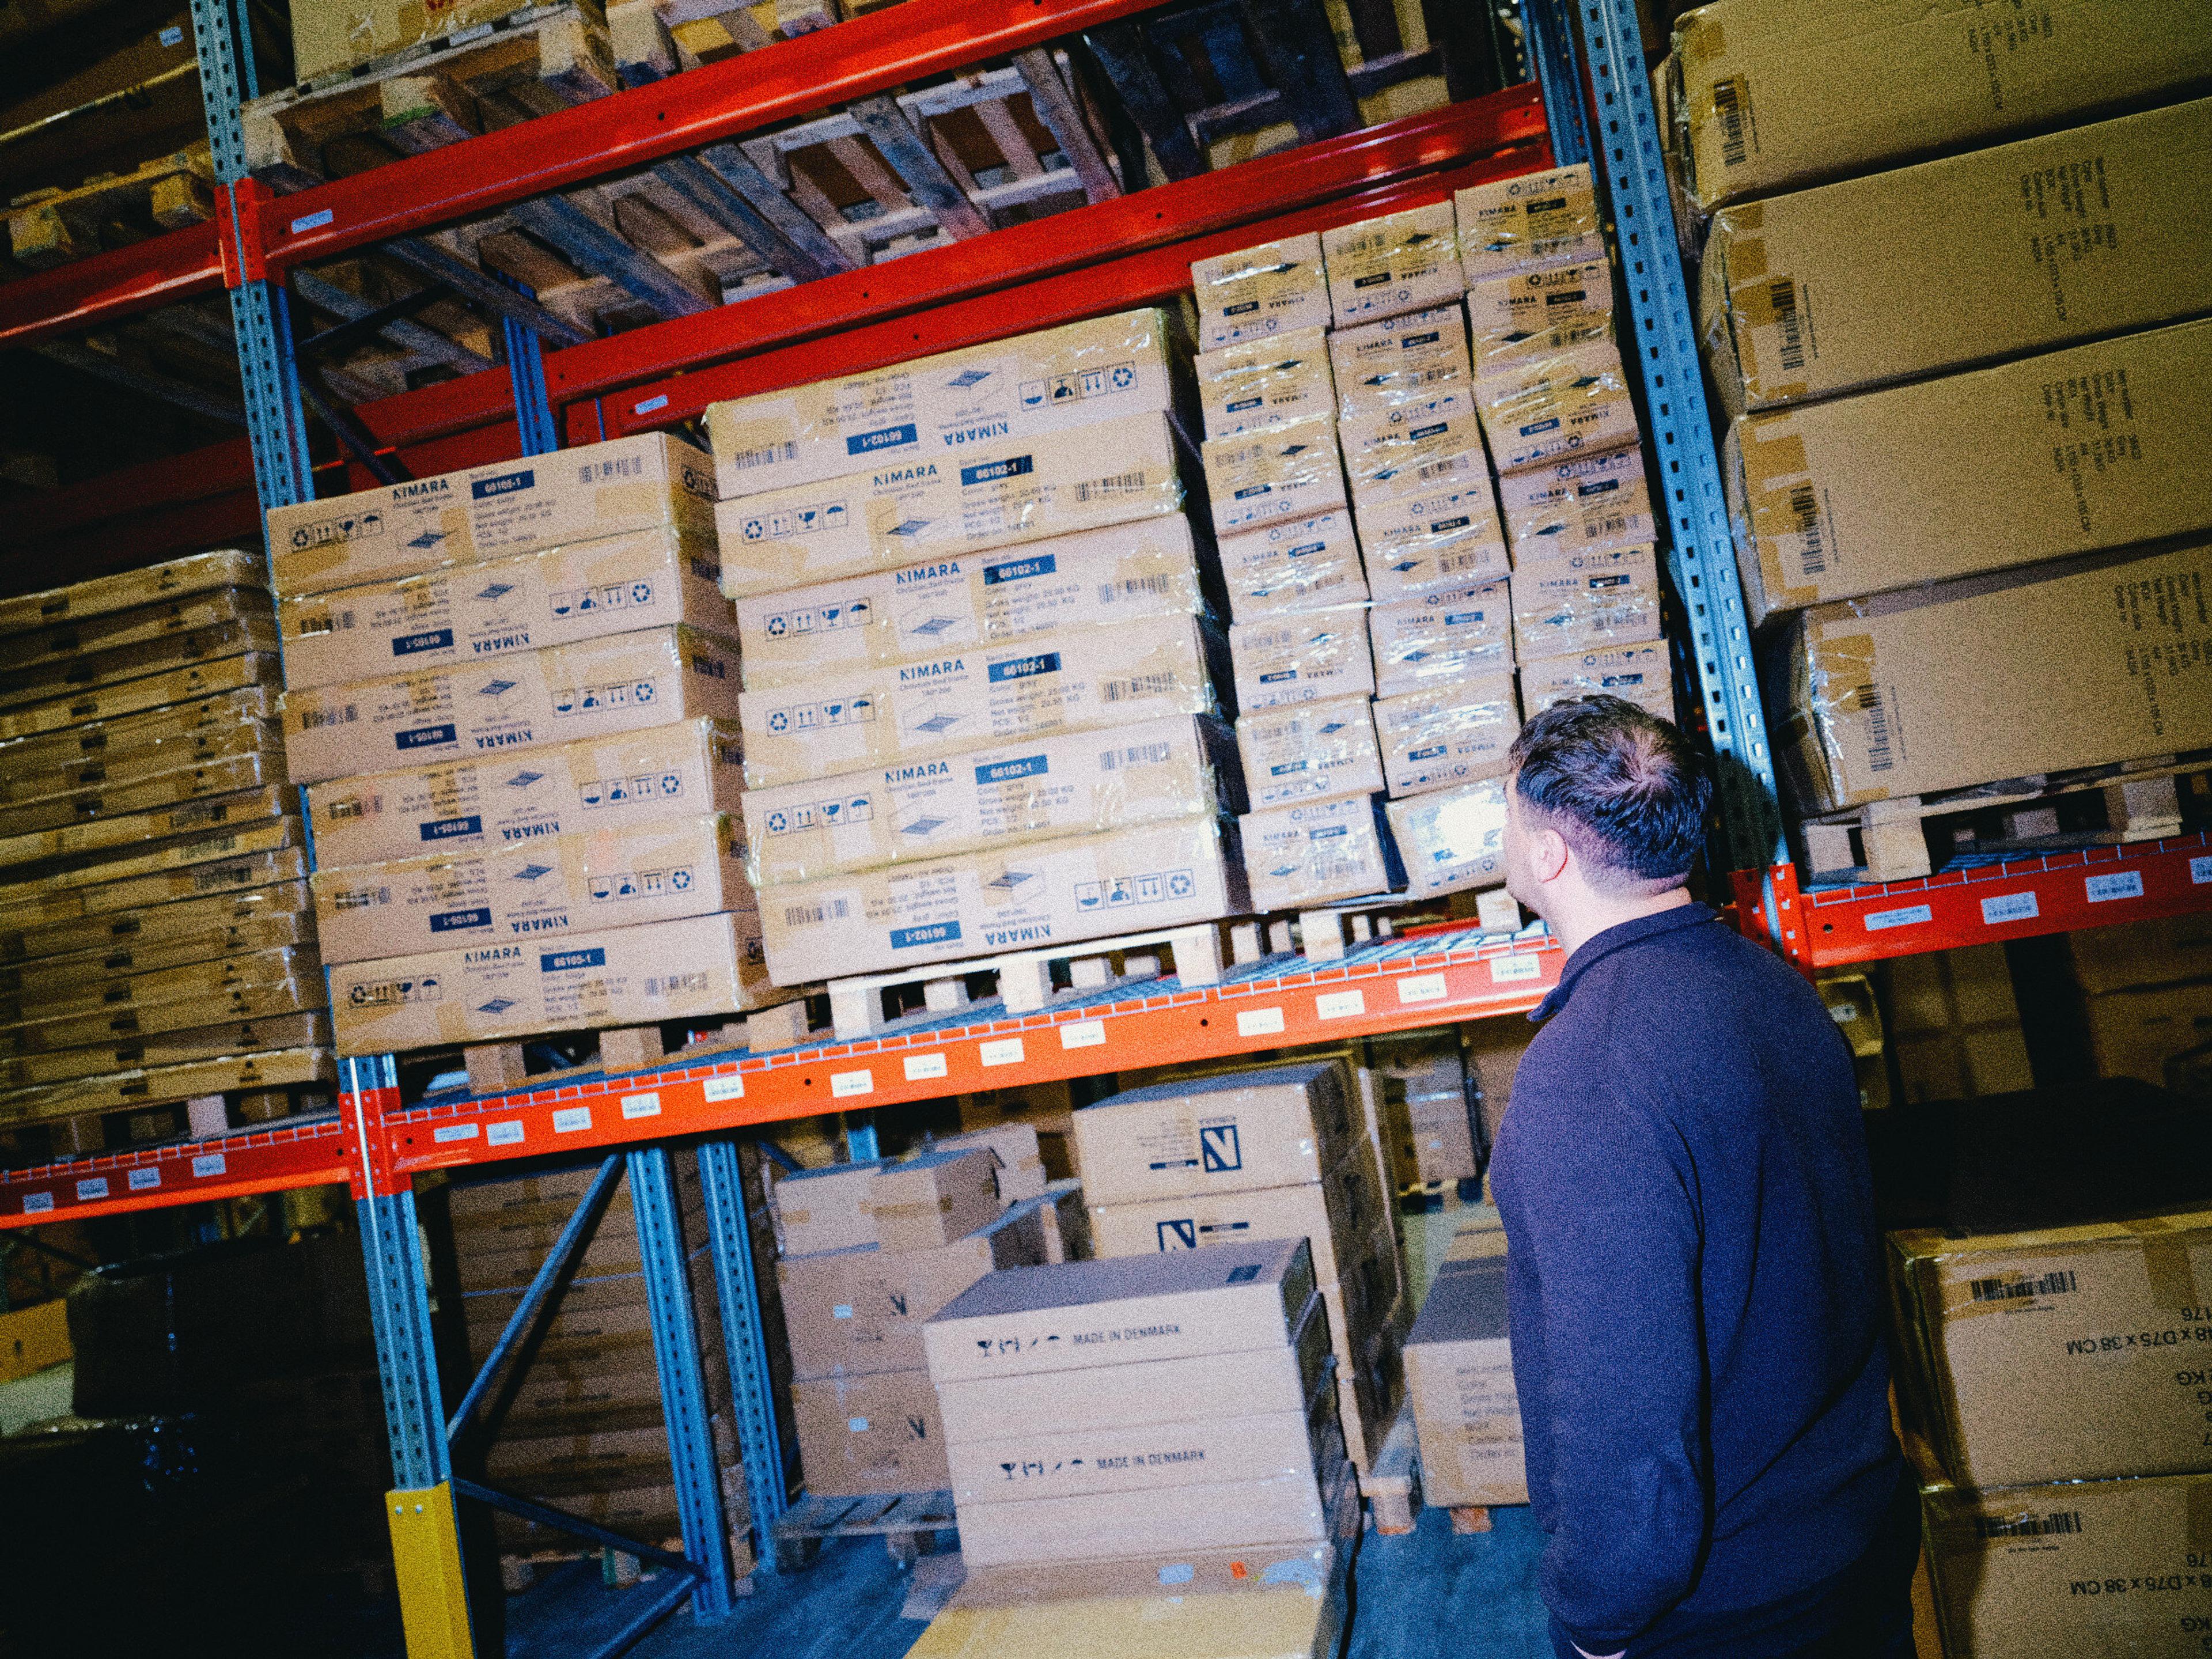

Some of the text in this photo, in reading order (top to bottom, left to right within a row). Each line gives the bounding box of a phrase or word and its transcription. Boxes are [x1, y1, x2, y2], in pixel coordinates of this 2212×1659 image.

[861, 430, 902, 447] 66102-1
[975, 462, 1017, 479] 66102-1
[998, 561, 1040, 578] 66102-1
[1002, 659, 1045, 676] 66102-1
[990, 762, 1032, 778] 66102-1
[904, 926, 946, 942] 66102-1
[1072, 1323, 1181, 1345] MADE IN DENMARK
[2125, 1335, 2137, 1346] x
[2065, 1338, 2097, 1355] CM
[2099, 1336, 2123, 1351] 38
[2175, 1369, 2206, 1386] KG
[1096, 1448, 1206, 1471] MADE IN DENMARK
[2069, 1580, 2101, 1596] CM
[2104, 1578, 2127, 1593] 38
[2130, 1577, 2140, 1589] x
[2180, 1615, 2210, 1632] KG
